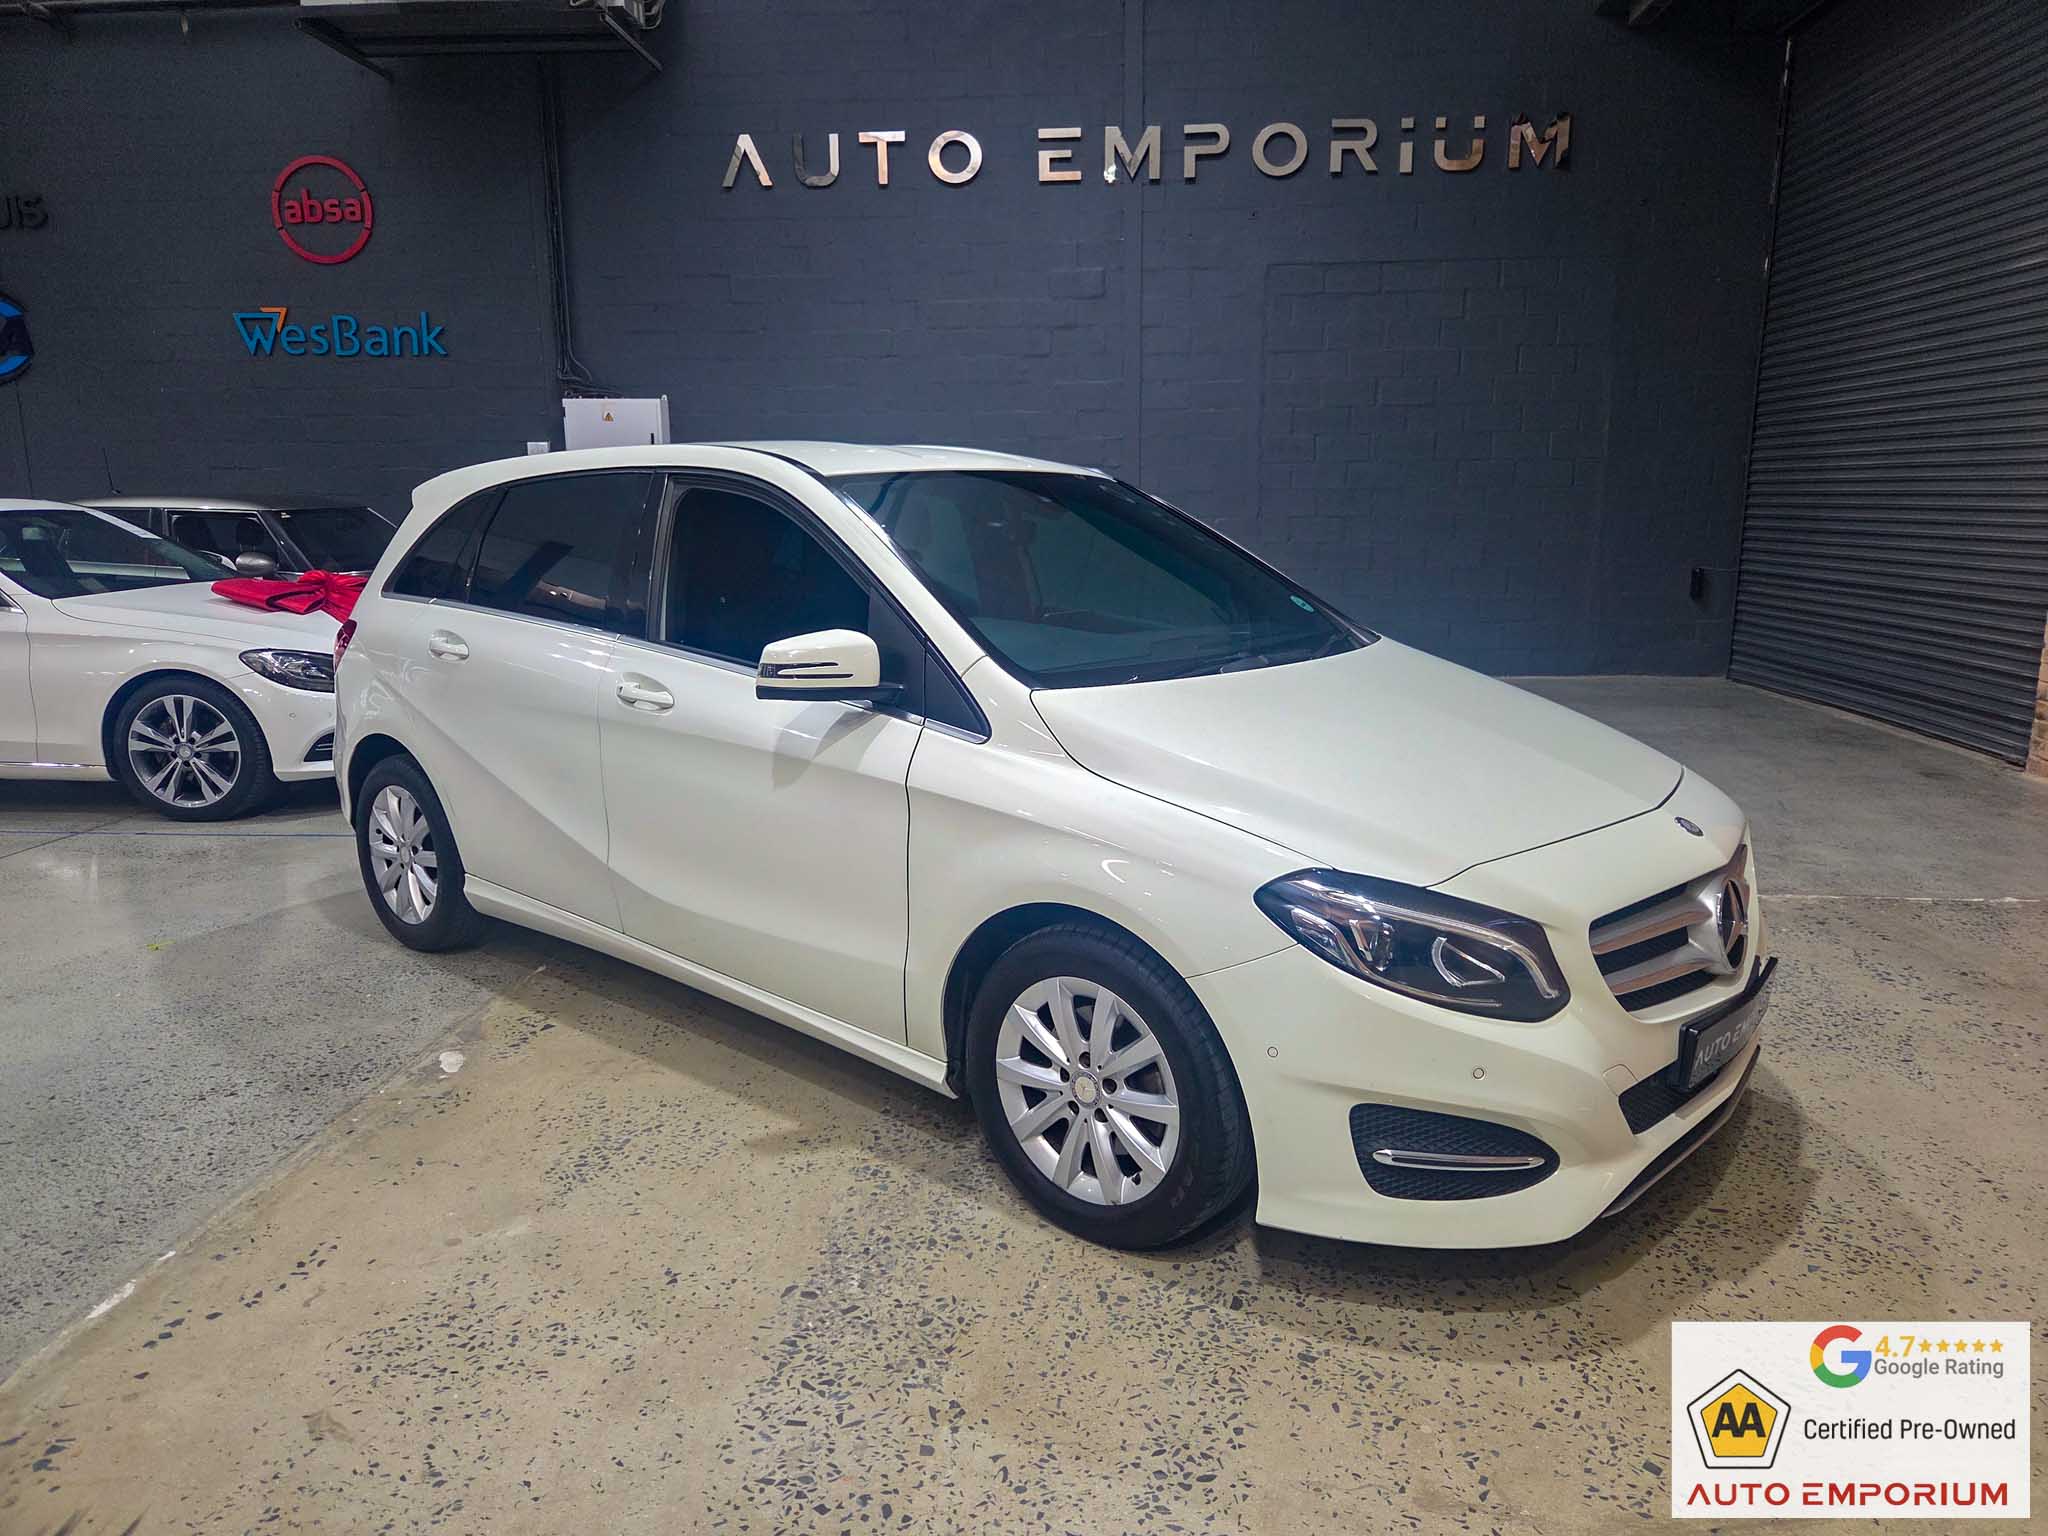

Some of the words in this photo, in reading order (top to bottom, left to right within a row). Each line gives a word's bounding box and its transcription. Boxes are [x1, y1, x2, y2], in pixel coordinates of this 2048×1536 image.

[721, 129, 983, 188] AUTO
[284, 188, 362, 224] absa
[233, 307, 448, 356] WesBank
